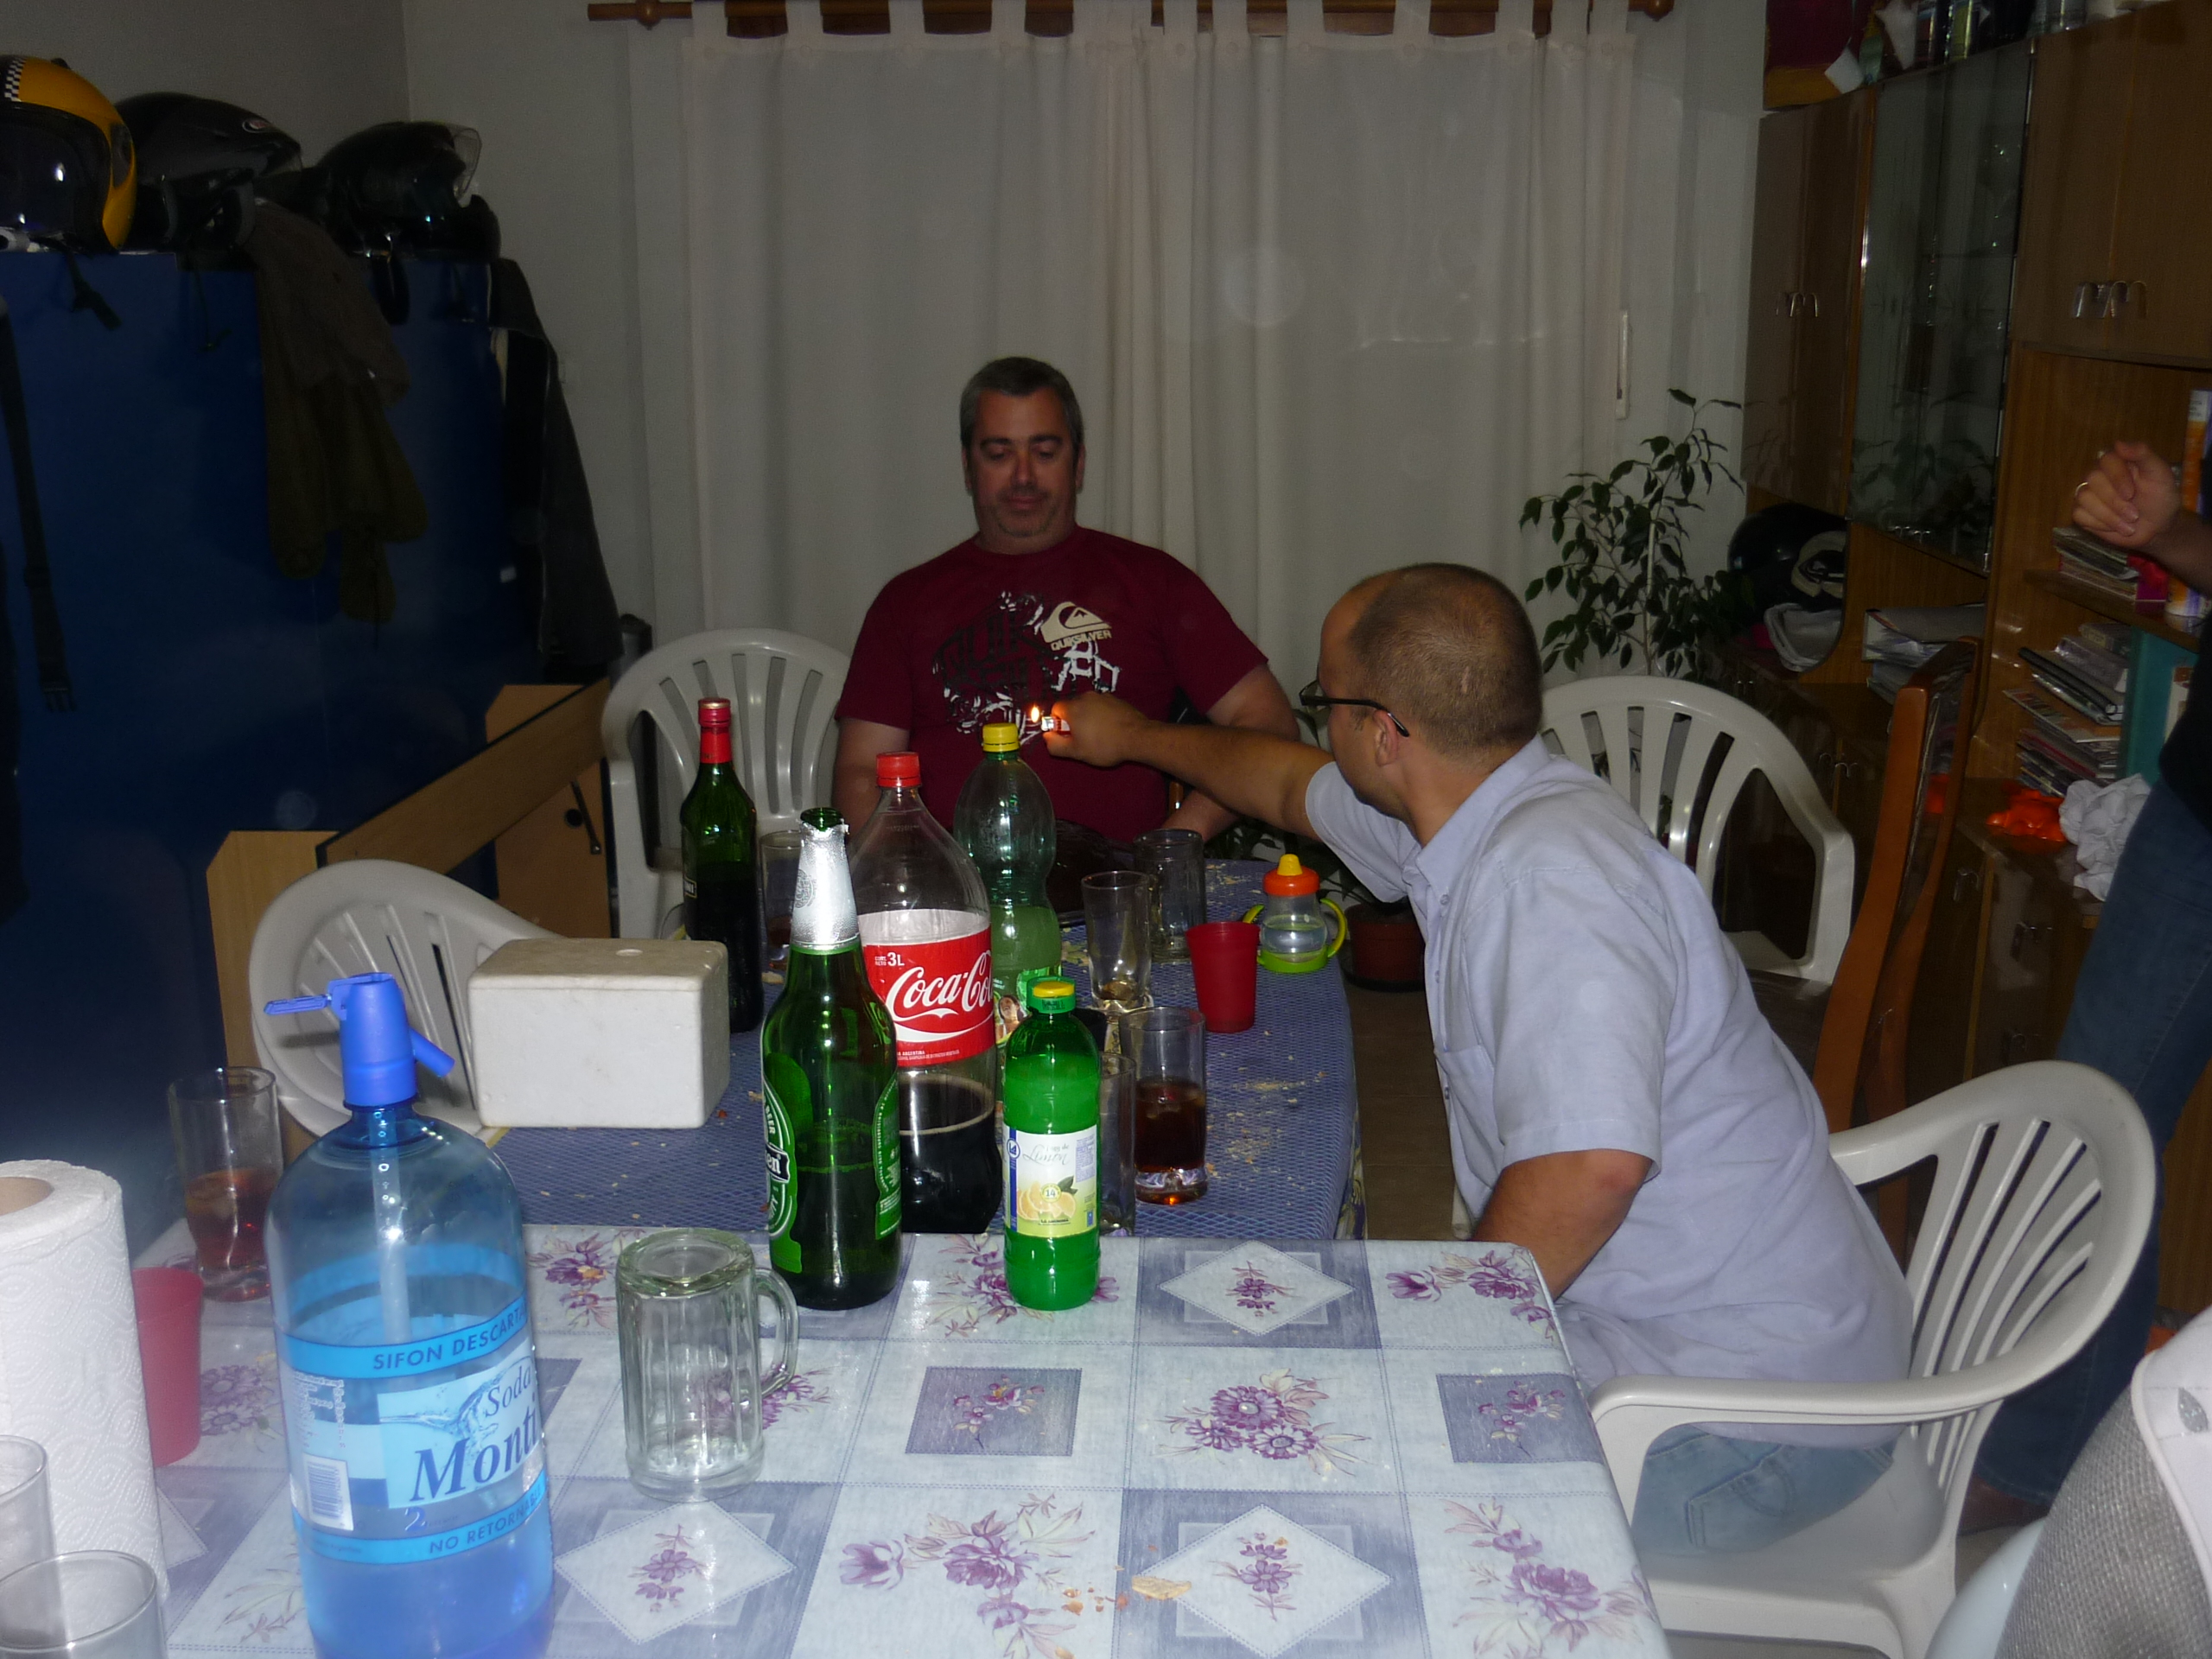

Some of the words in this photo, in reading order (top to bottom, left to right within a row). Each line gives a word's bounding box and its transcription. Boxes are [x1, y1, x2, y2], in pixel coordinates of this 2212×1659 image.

[886, 950, 993, 1021] Coca-Col
[373, 1344, 442, 1370] SIFON
[485, 1364, 531, 1418] Soda
[409, 1392, 537, 1502] Monti
[429, 1535, 459, 1554] NO
